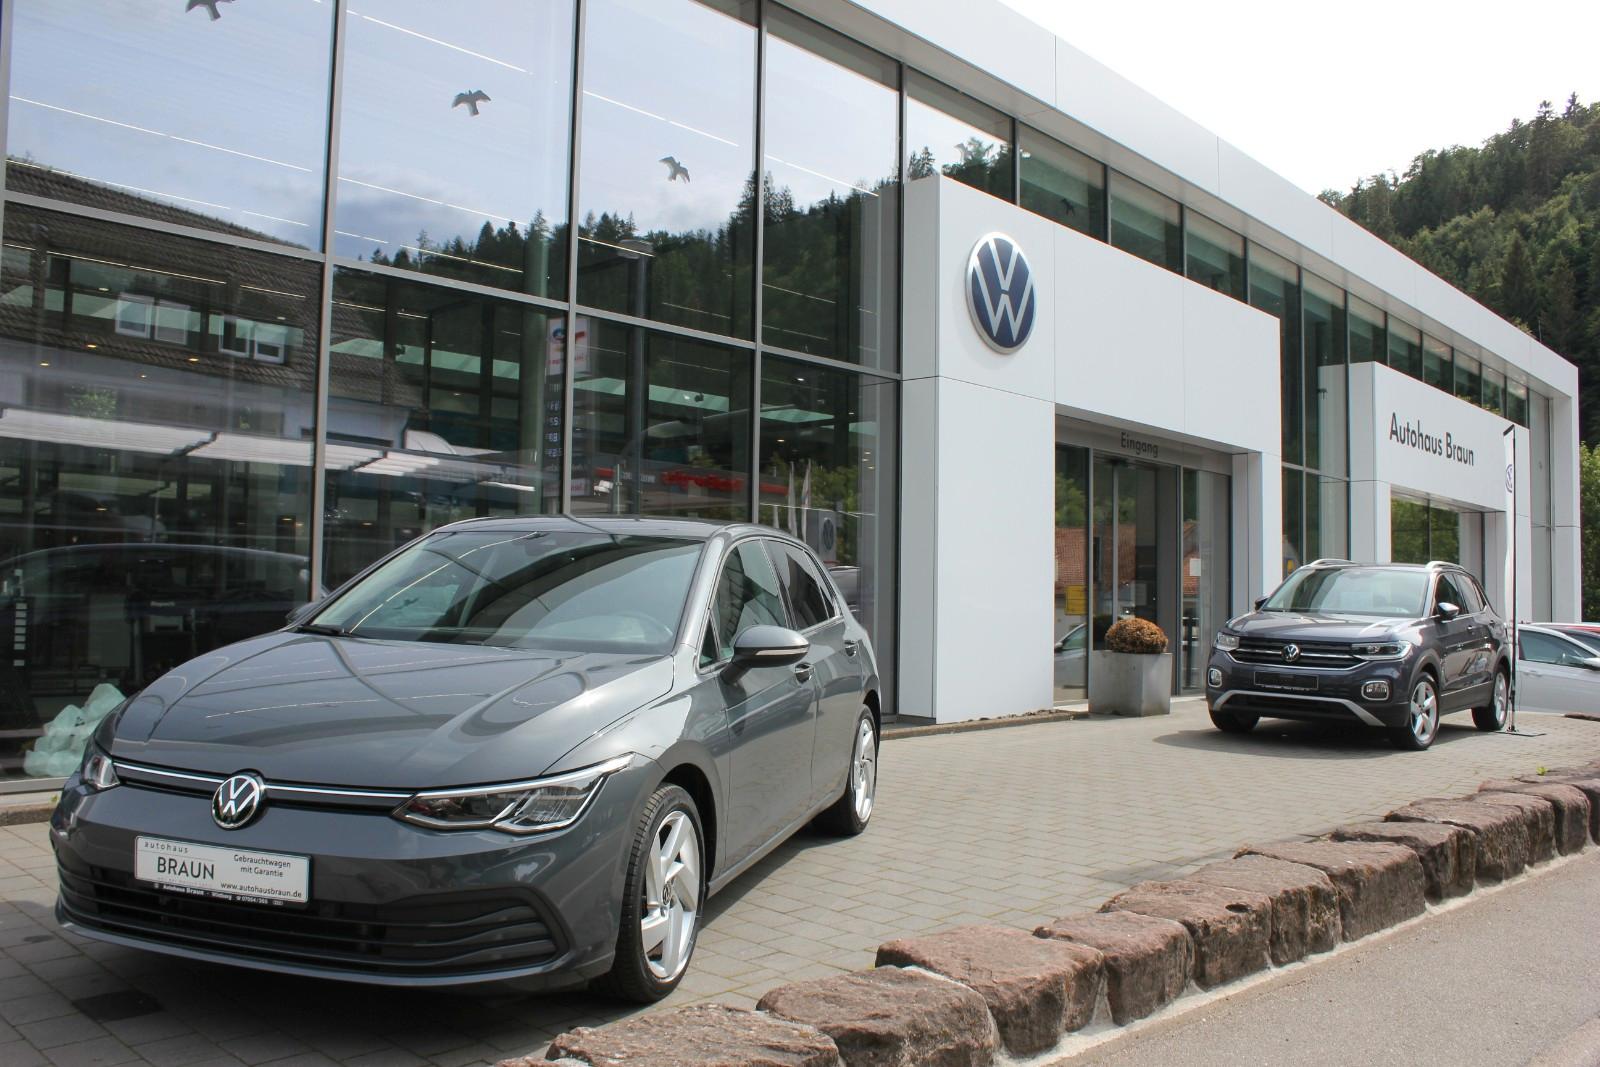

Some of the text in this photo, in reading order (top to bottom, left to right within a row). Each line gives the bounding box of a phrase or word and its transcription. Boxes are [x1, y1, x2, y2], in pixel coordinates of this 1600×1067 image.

[966, 232, 1036, 354] VW
[1120, 431, 1159, 458] Eingang
[1389, 411, 1475, 466] Autohaus Braun
[213, 775, 260, 828] VW
[144, 841, 189, 854] autohaus
[157, 856, 215, 880] BRAUN
[233, 854, 291, 869] Gebrauchtwagen
[240, 865, 284, 878] mit Garantie
[220, 882, 302, 898] www.autohausbraun.de
